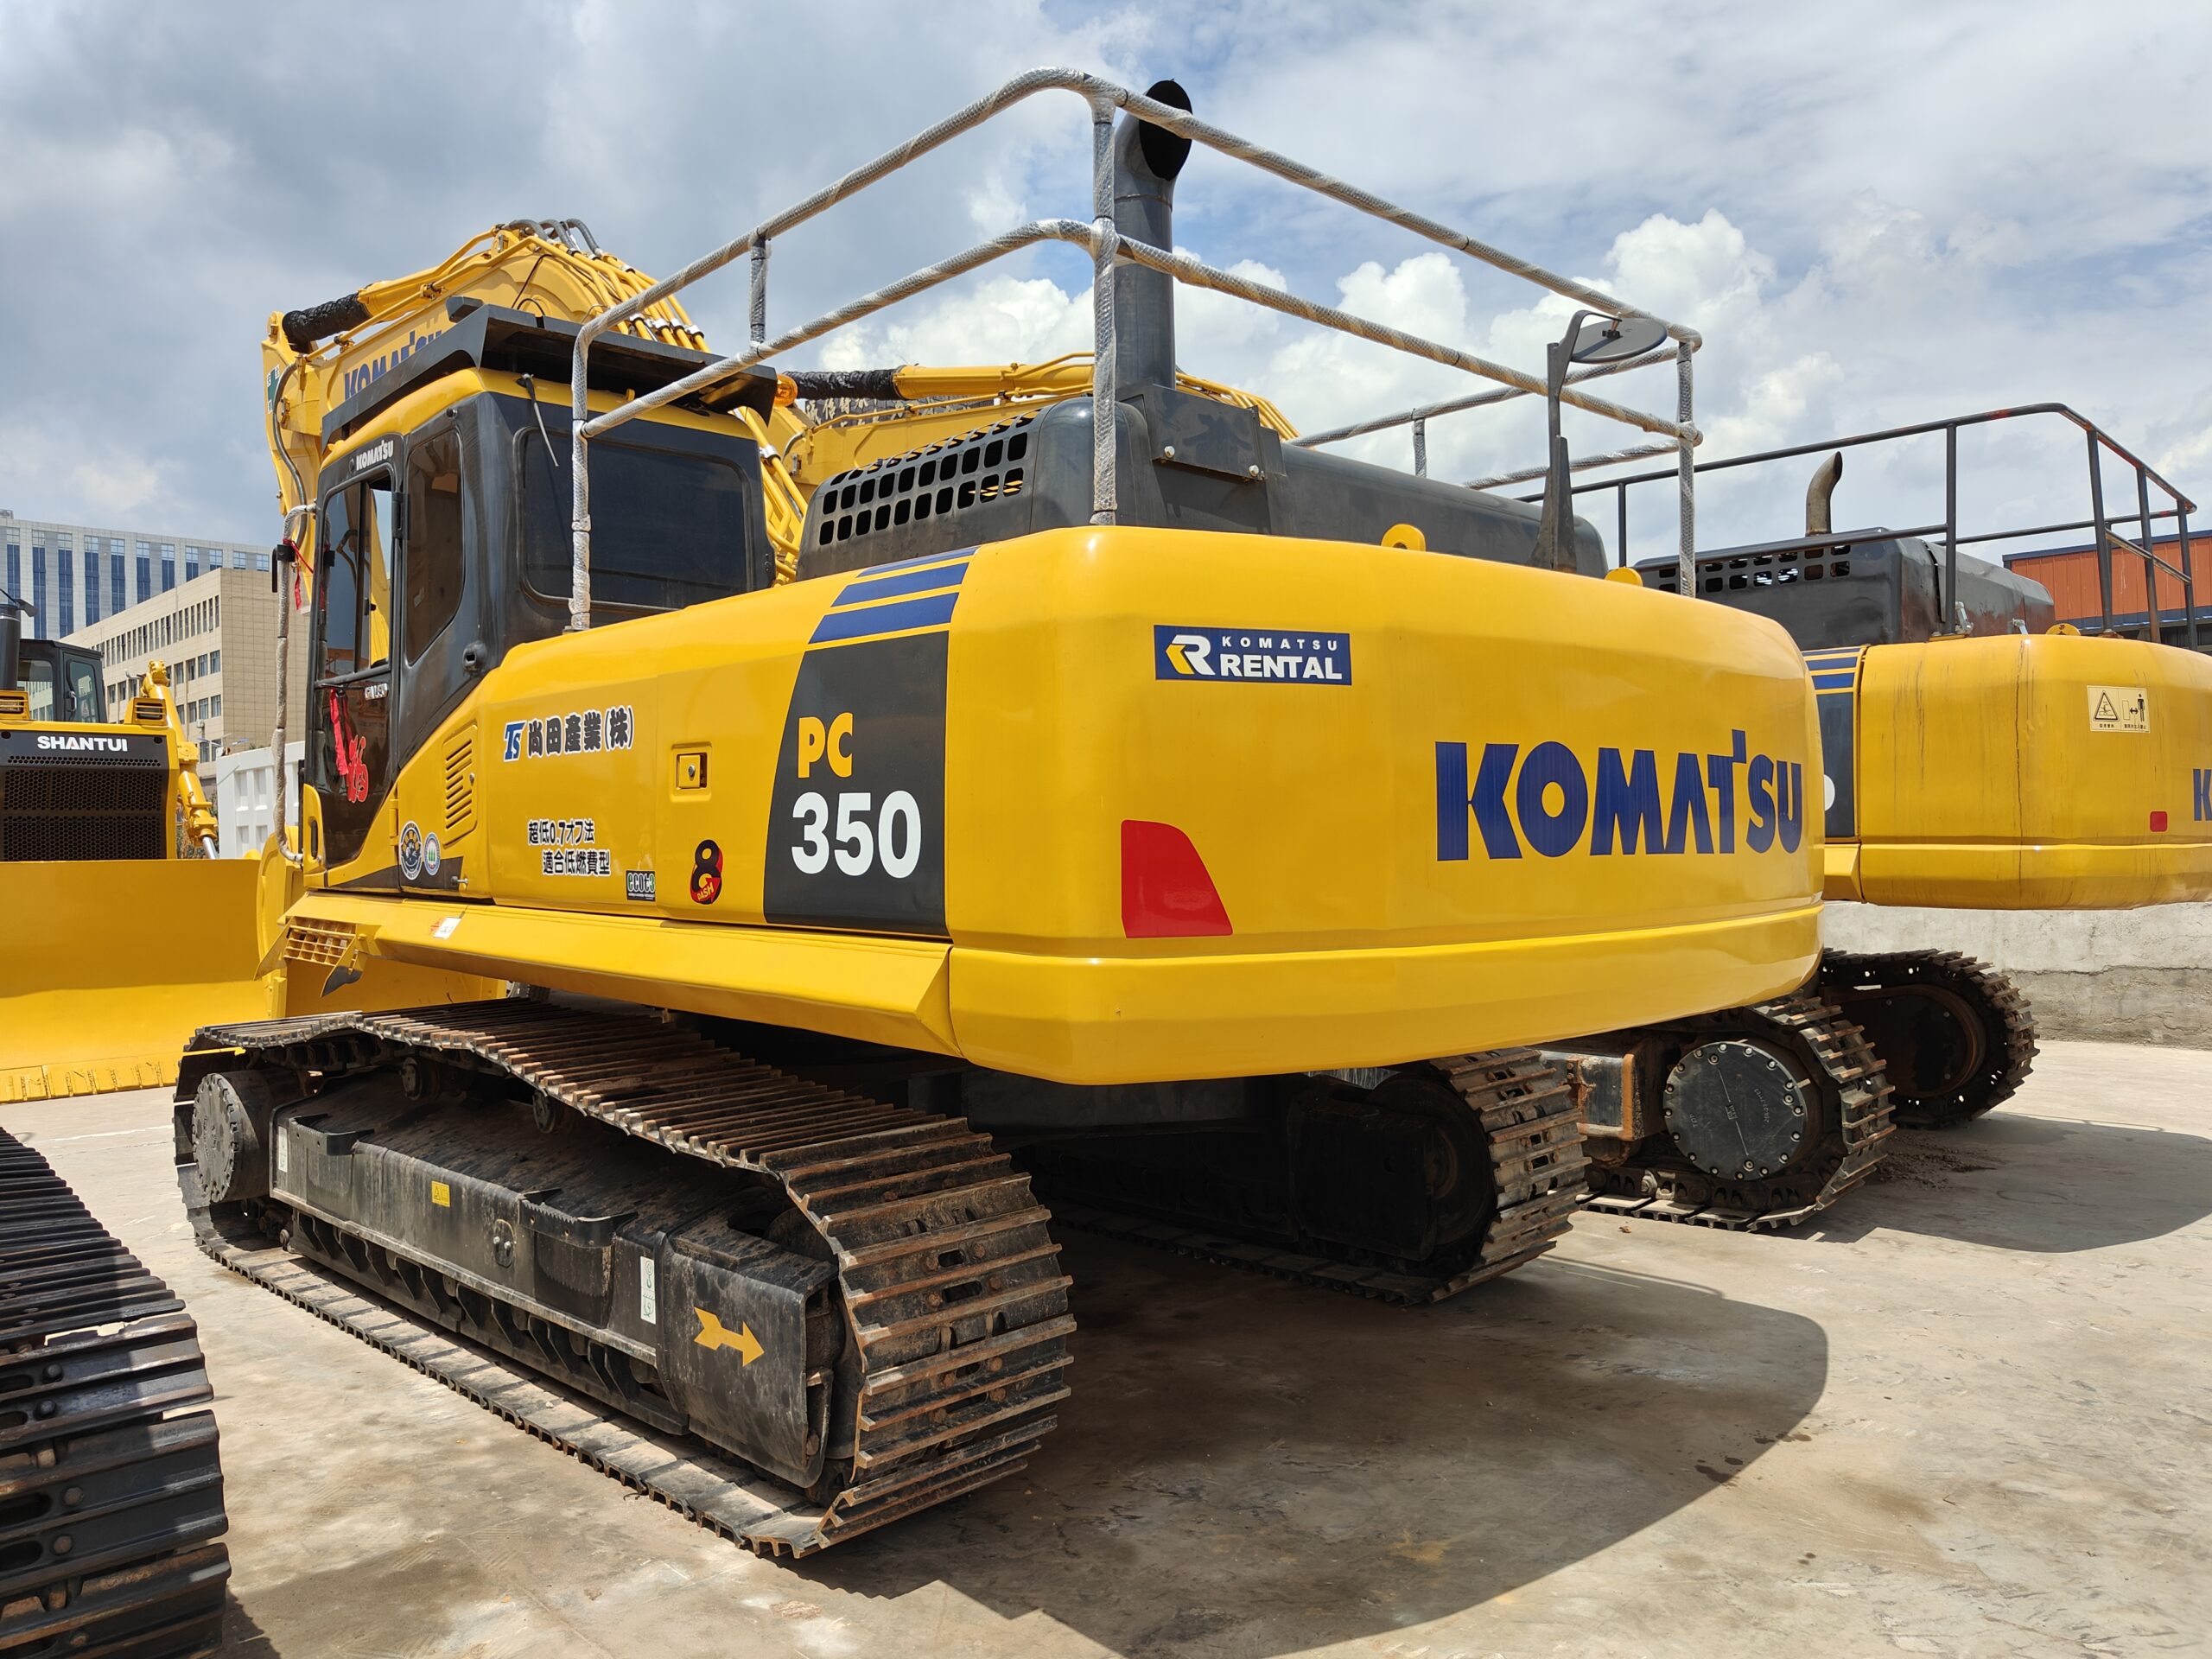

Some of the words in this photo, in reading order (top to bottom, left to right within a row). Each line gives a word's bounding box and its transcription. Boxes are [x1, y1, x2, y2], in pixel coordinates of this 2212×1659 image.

[344, 330, 442, 401] KOMT
[356, 439, 394, 471] KOMATSU
[1222, 636, 1337, 651] KOMATSU
[1220, 654, 1342, 679] RENTAL
[37, 736, 129, 752] SHANTUI
[798, 712, 853, 779] PC
[1435, 729, 1802, 861] KOMATSU
[791, 790, 922, 879] 350
[543, 849, 611, 875] 適合低燃費型
[627, 873, 656, 893] ecot3
[696, 881, 715, 900] DASH
